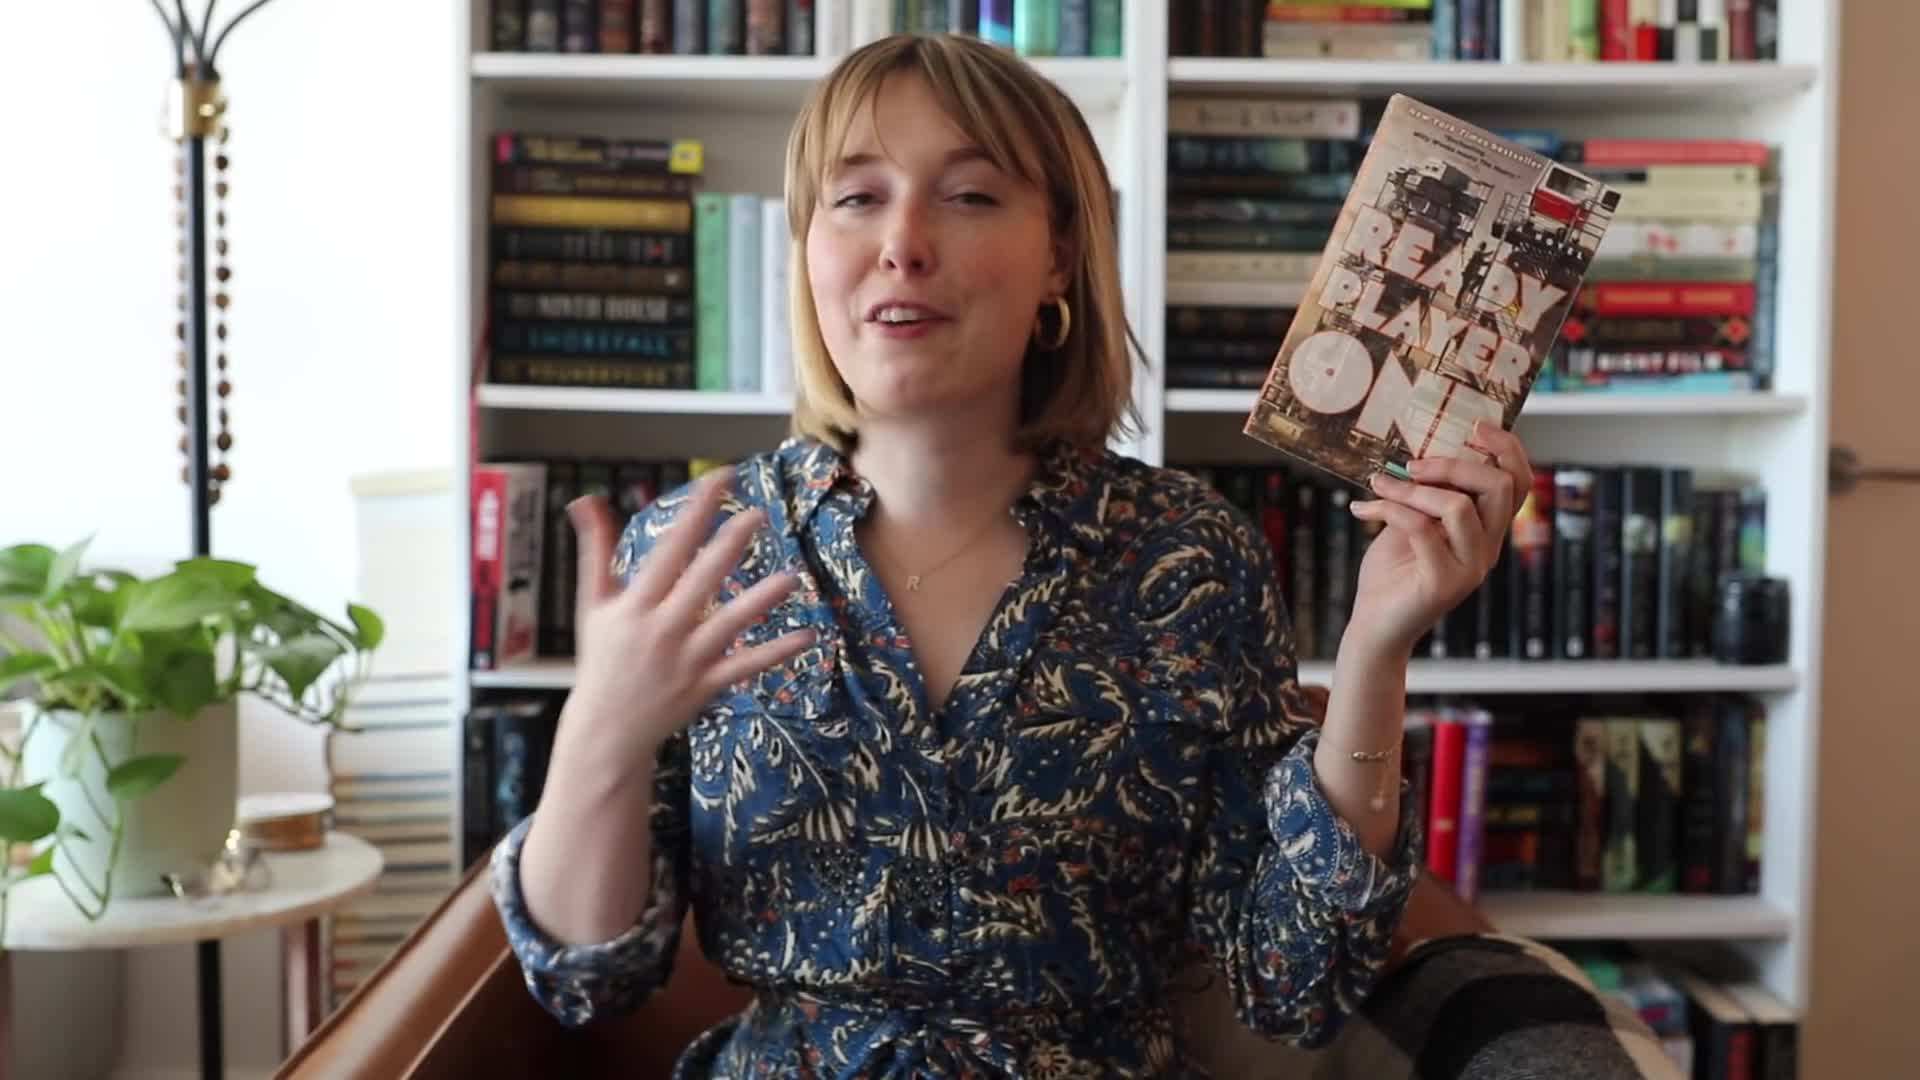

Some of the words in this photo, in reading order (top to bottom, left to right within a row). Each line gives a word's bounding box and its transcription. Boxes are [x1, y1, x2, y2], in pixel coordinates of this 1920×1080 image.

[1343, 203, 1568, 333] READY
[1535, 232, 1584, 261] NOVEL
[1318, 264, 1531, 394] PLAYER
[906, 575, 921, 591] R
